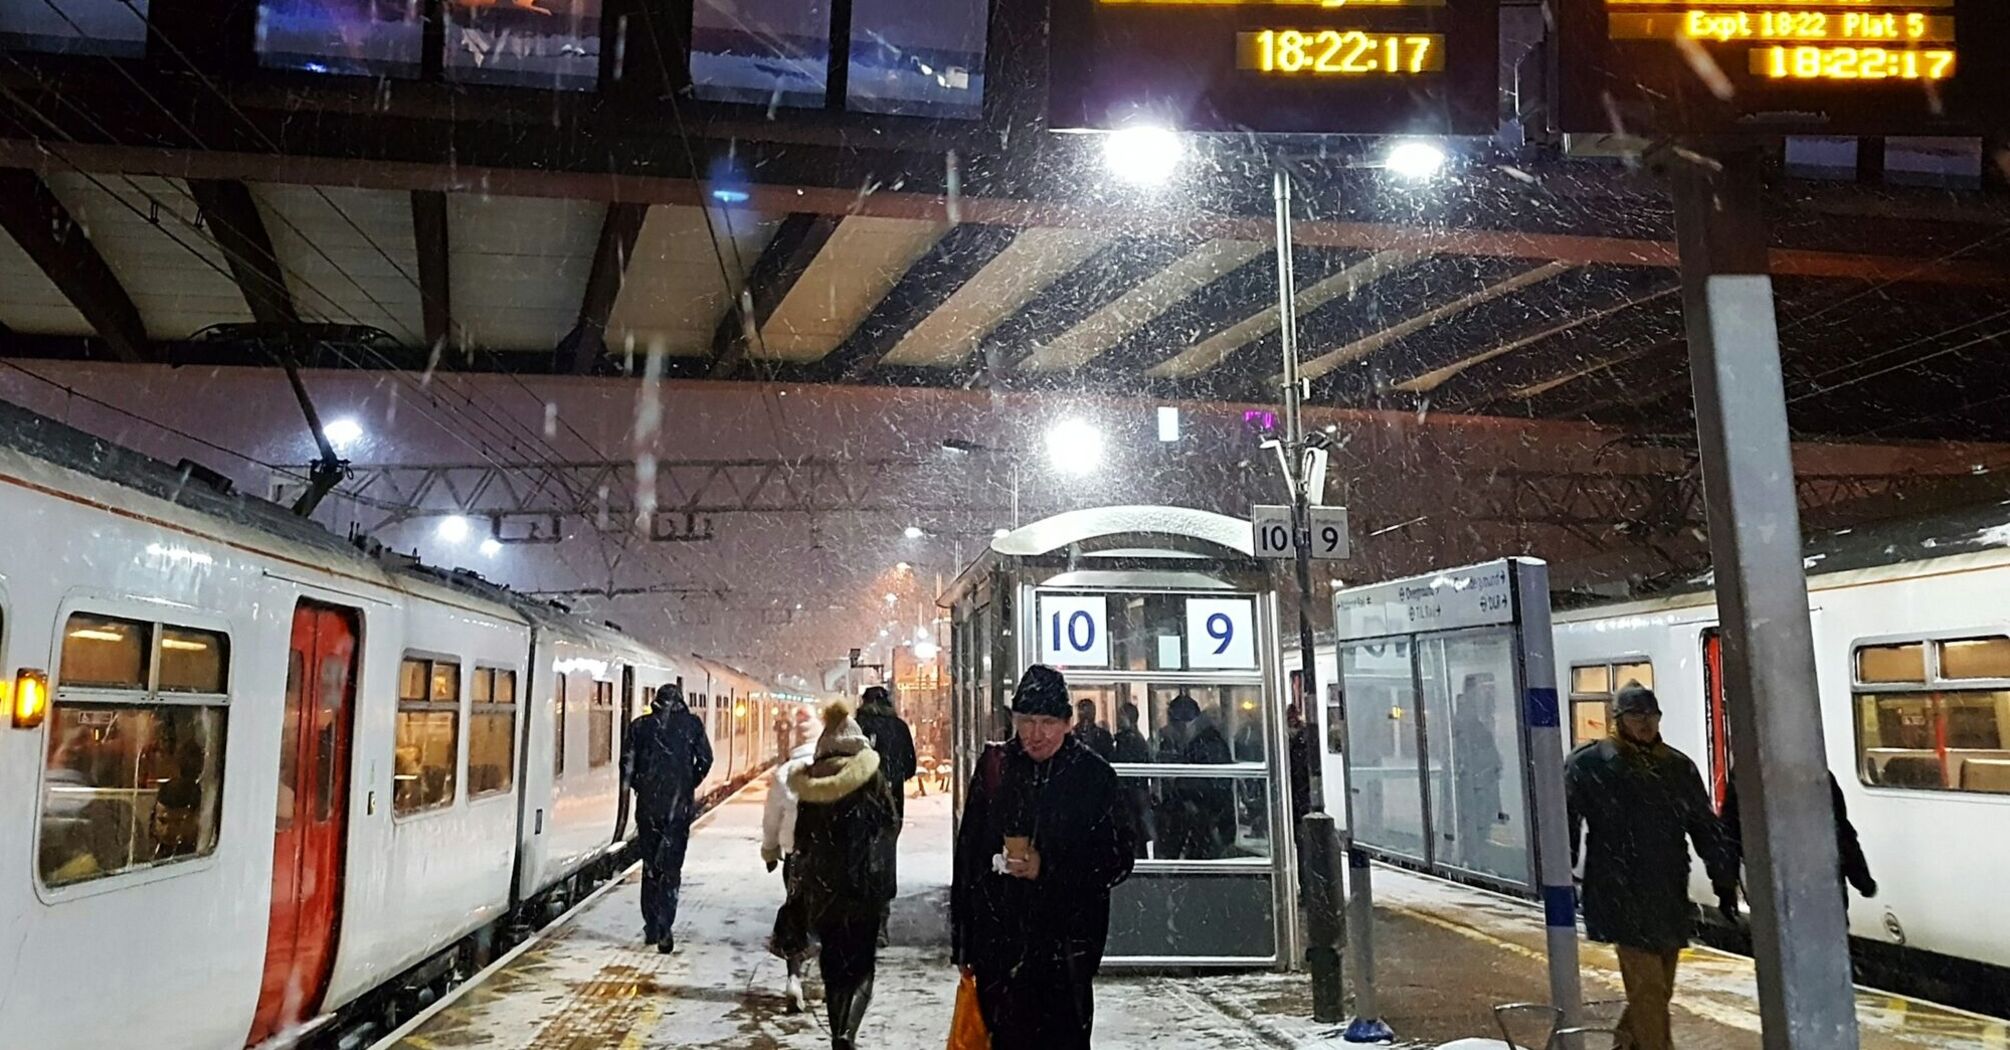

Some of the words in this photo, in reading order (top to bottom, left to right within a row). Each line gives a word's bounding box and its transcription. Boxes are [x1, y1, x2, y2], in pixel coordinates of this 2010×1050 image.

[1686, 10, 1752, 41] Expt
[1760, 11, 1827, 38] 18:22
[1843, 12, 1899, 38] Plat
[1906, 13, 1925, 38] 5
[1257, 30, 1431, 73] 18:22:17
[1768, 46, 1955, 79] 18:22:17
[1261, 525, 1288, 551] 10
[1321, 526, 1339, 552] 9
[1052, 609, 1096, 652] 10
[1206, 612, 1234, 655] 9
